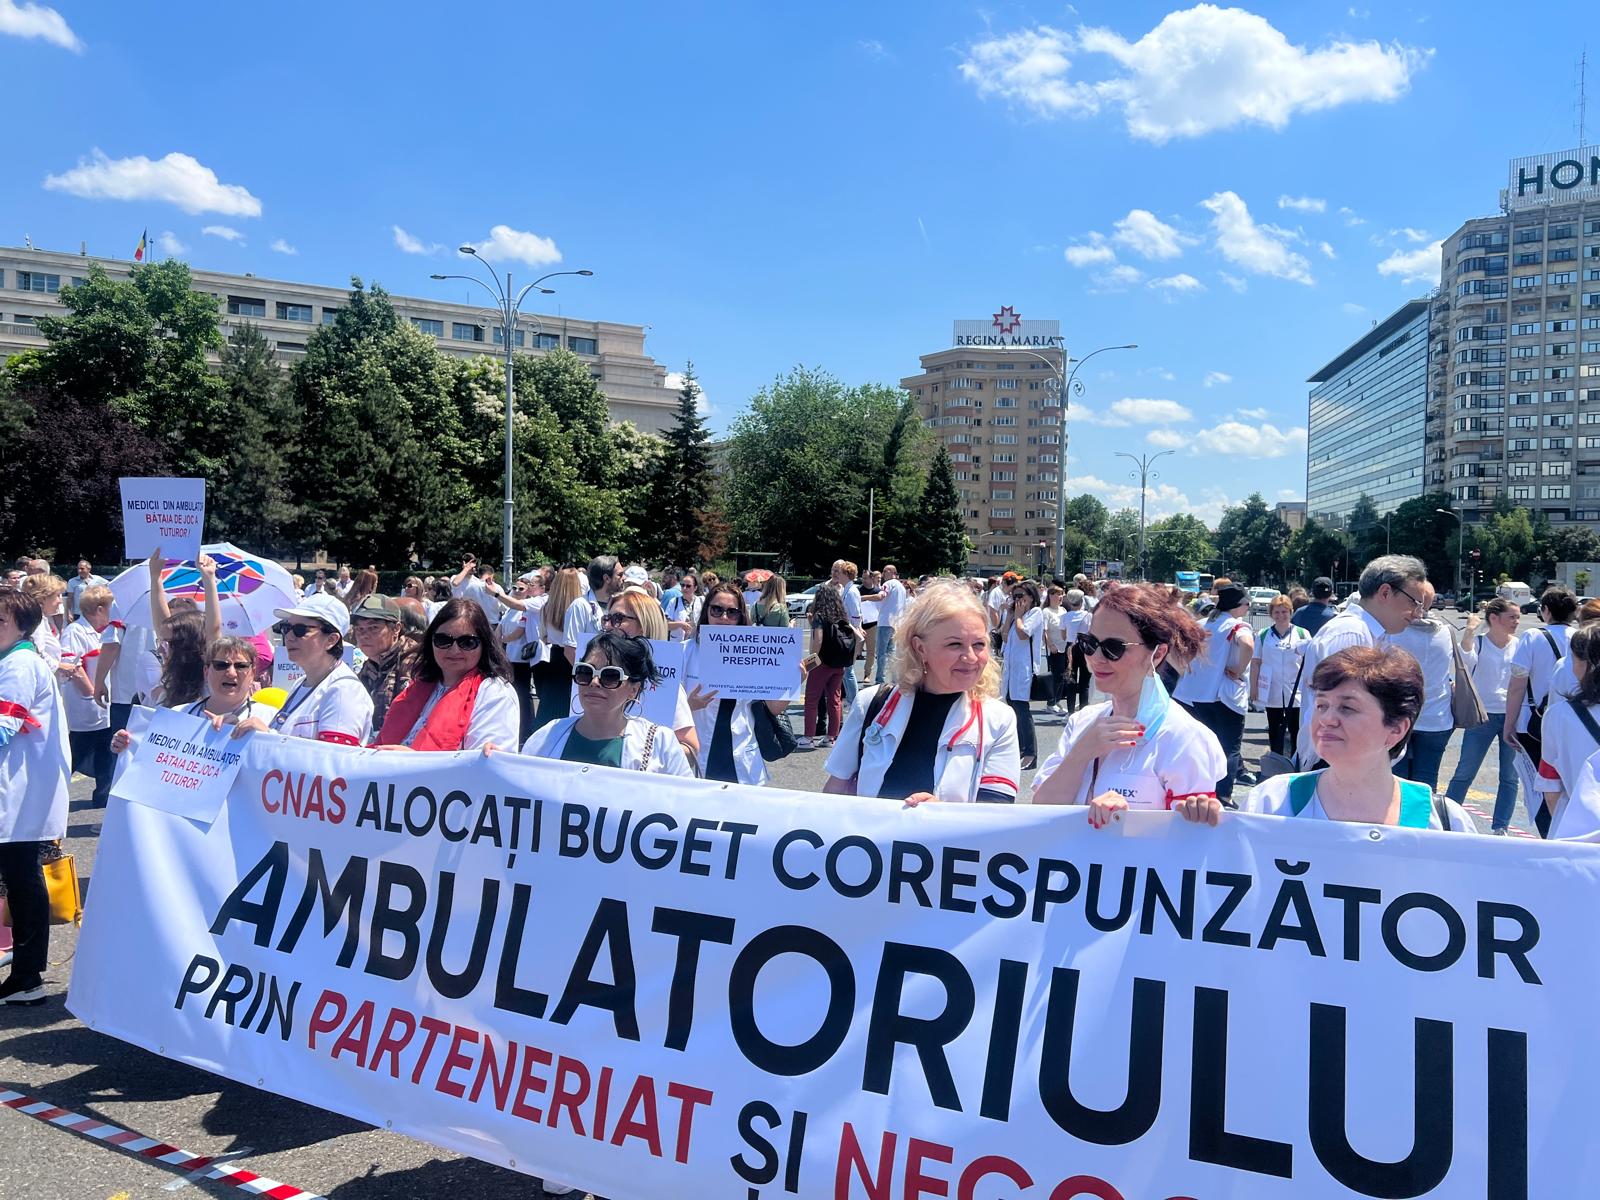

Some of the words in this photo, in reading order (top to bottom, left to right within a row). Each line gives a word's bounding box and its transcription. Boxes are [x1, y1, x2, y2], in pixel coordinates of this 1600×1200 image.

[957, 335, 1006, 346] REGINA
[1011, 335, 1055, 346] MARIA
[127, 501, 159, 510] MEDICII
[163, 501, 174, 510] DIN
[174, 515, 183, 524] DE
[183, 515, 195, 525] JOC
[709, 633, 759, 643] VALOARE
[763, 634, 796, 645] UNICĂ
[719, 643, 730, 653] ÎN
[733, 645, 785, 655] MEDICINA
[722, 656, 780, 666] PRESPITAL
[657, 666, 676, 679] TOR
[148, 732, 181, 750] MEDICII
[182, 742, 199, 756] DIN
[197, 746, 240, 766] AMBULATOR
[186, 761, 200, 773] DE
[198, 764, 214, 777] JOC
[212, 768, 220, 778] A
[261, 769, 348, 825] CNAS
[356, 781, 543, 869] ALOCAȚI
[559, 802, 758, 880] BUGET
[772, 829, 1543, 985] CORESPUNZĂTOR
[209, 841, 1528, 1200] AMBULATORIULUI
[174, 953, 302, 1042] PRIN
[308, 989, 714, 1165] PARTENERIAT
[730, 1100, 808, 1200] ȘI
